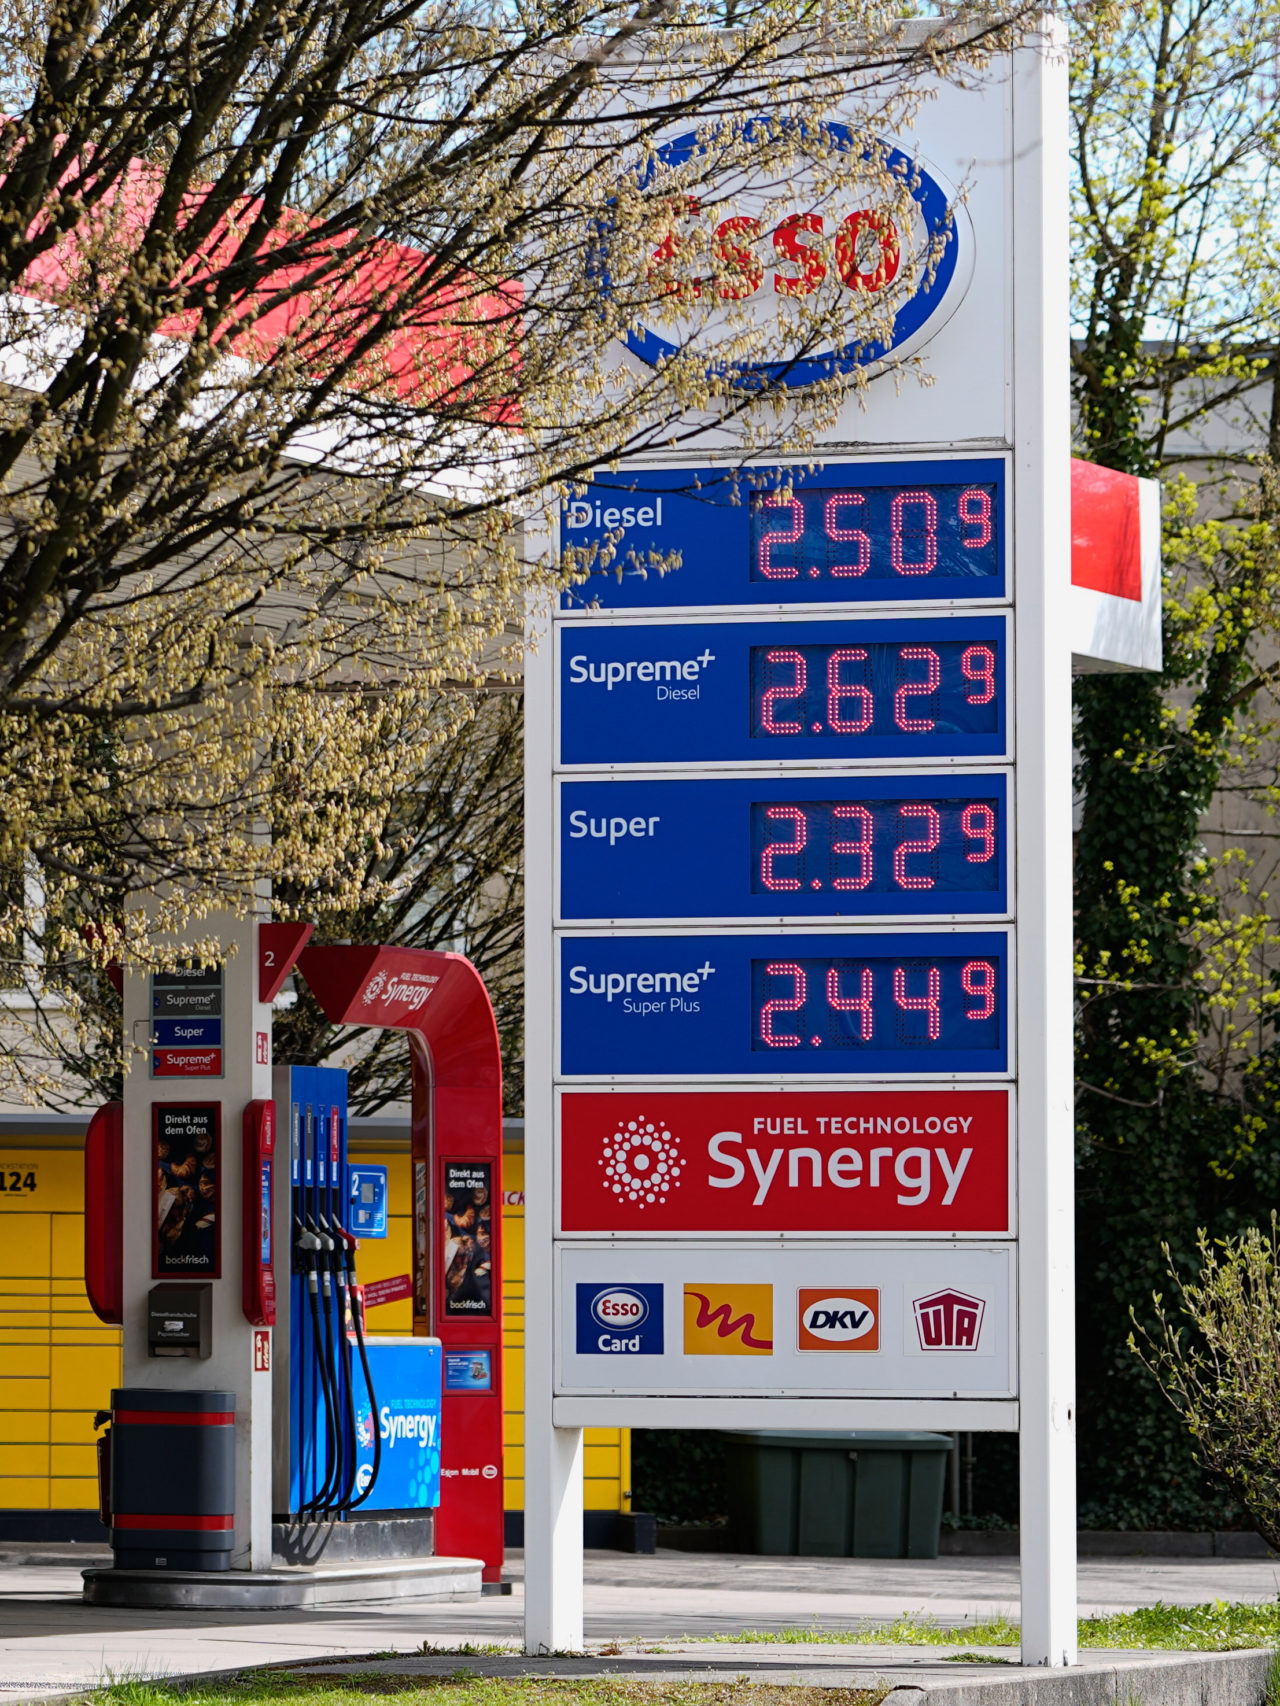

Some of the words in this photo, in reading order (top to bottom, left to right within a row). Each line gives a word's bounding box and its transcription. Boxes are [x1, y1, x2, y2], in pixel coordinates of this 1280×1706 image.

[648, 195, 901, 300] sso
[568, 497, 662, 529] Diesel
[656, 684, 701, 701] Diesel
[569, 810, 661, 846] Super
[264, 951, 275, 967] 2
[175, 966, 206, 977] Diesel
[381, 977, 434, 1010] Synergy
[622, 998, 666, 1017] Super
[669, 997, 701, 1014] Plus
[174, 1026, 205, 1039] Super
[165, 1114, 191, 1124] Direkt
[192, 1116, 208, 1124] aus
[753, 1117, 809, 1135] FUEL
[816, 1116, 974, 1135] TECHNOLOGY
[165, 1125, 184, 1135] dem
[186, 1125, 207, 1135] Ofen
[449, 1168, 471, 1178] Direkt
[472, 1171, 485, 1179] aus
[707, 1131, 974, 1206] Synergy
[351, 1174, 359, 1196] 2
[449, 1179, 465, 1188] dem
[466, 1179, 484, 1188] Ofen
[165, 1254, 209, 1264] backfrisch
[450, 1299, 486, 1309] backfrisch
[601, 1299, 640, 1316] Esso
[808, 1310, 869, 1329] DKV
[597, 1334, 641, 1352] Card
[380, 1406, 437, 1448] Synergy
